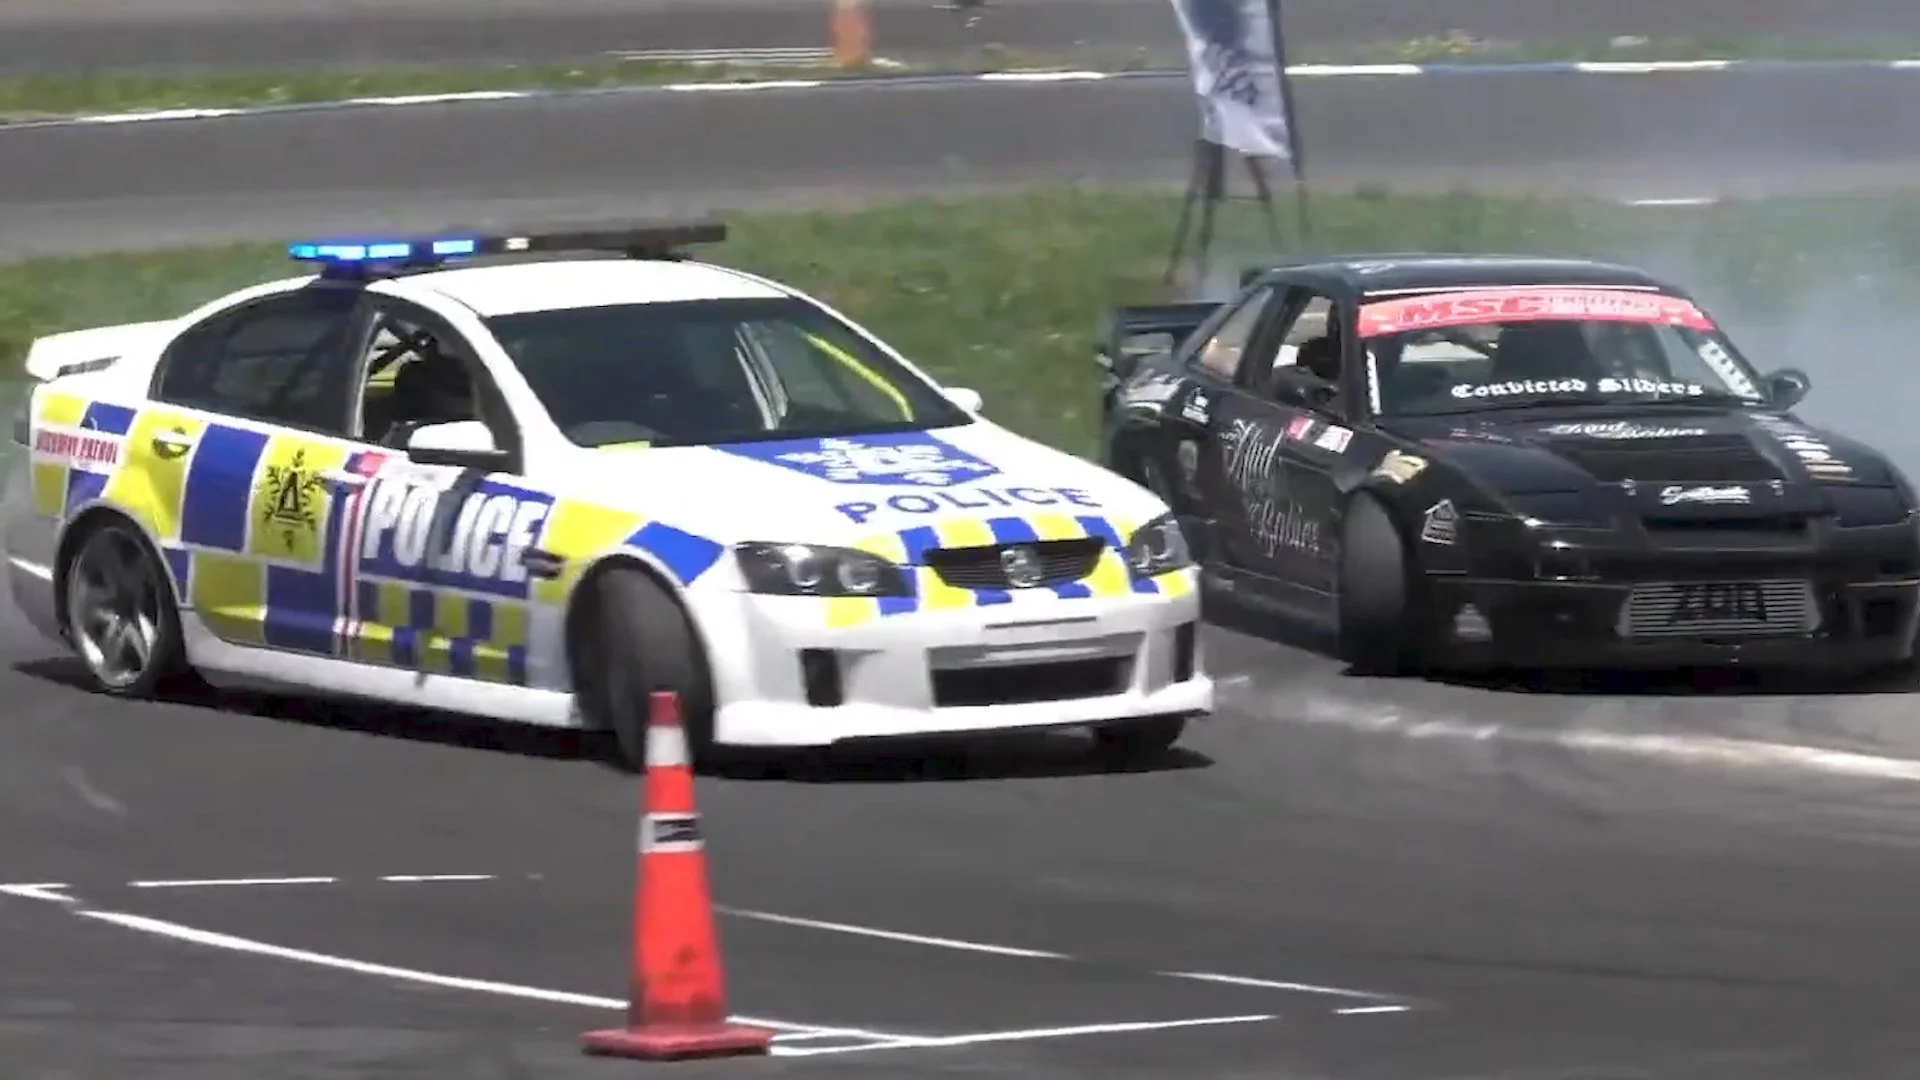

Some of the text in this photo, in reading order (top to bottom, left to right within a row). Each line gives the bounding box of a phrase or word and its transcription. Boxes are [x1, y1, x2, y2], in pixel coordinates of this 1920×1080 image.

[1451, 377, 1704, 399] Convicted Sliders
[79, 436, 119, 464] PATROL
[834, 487, 1103, 524] POLICE
[362, 474, 550, 582] POLICE
